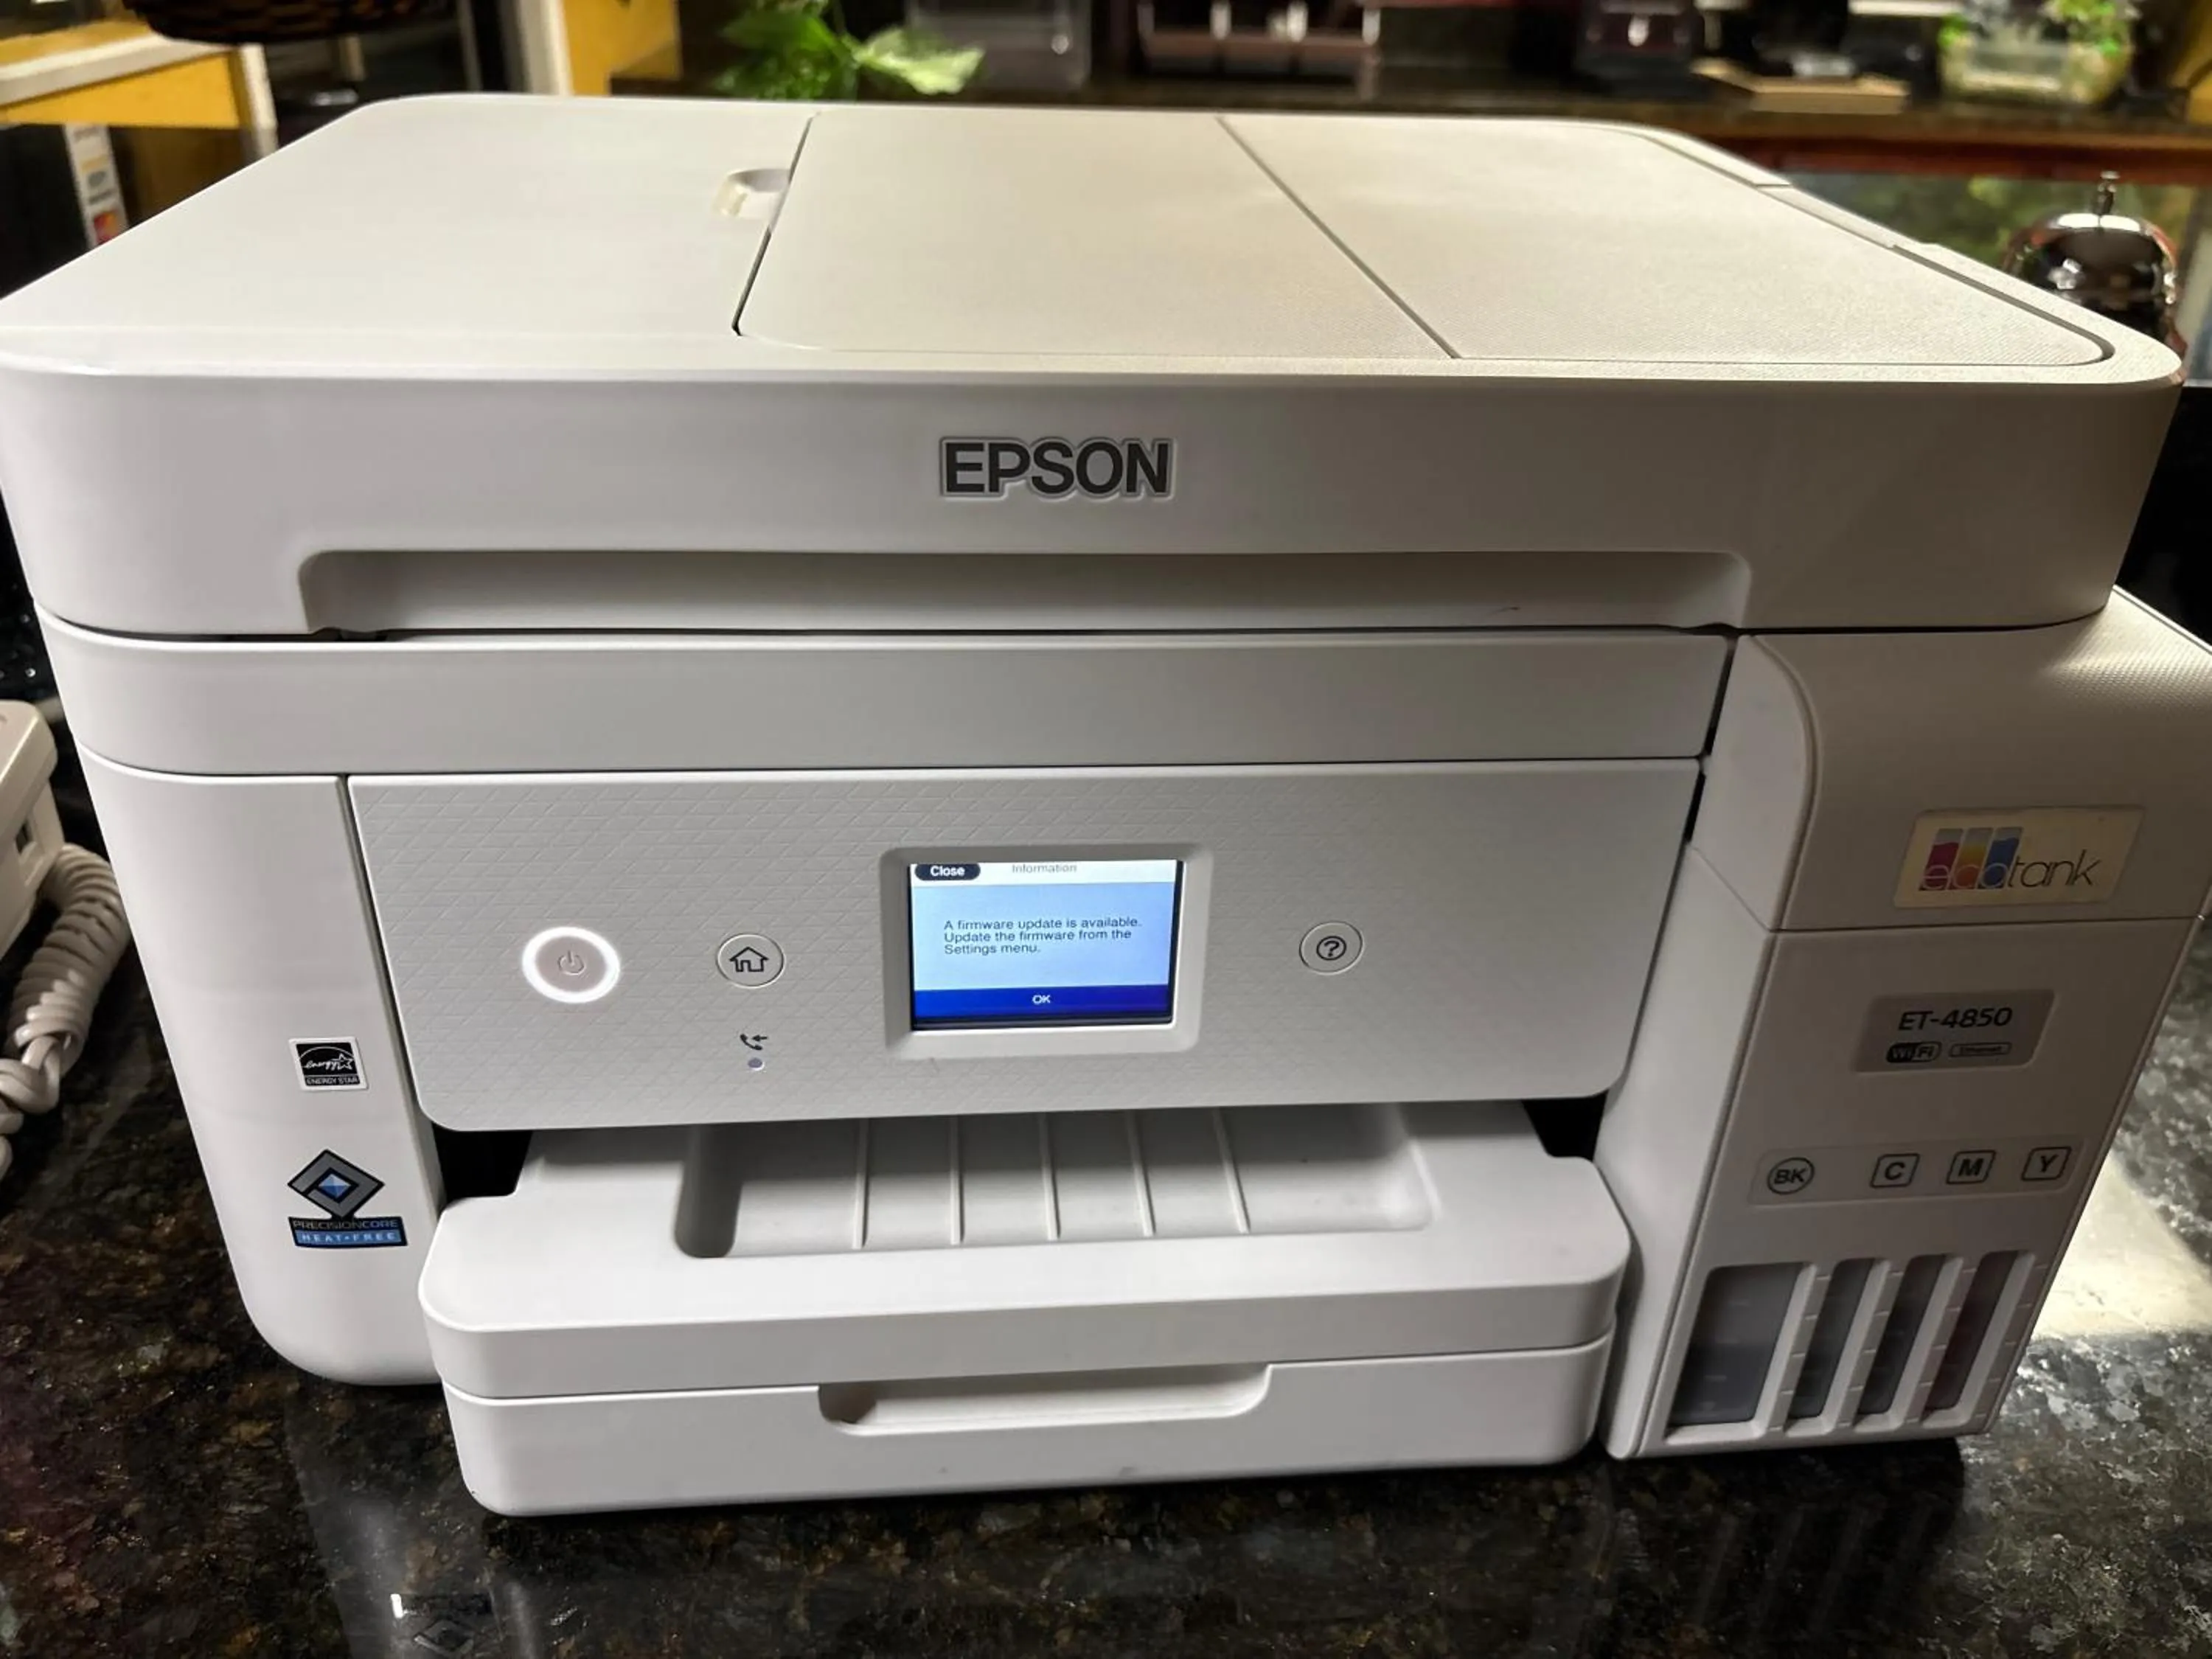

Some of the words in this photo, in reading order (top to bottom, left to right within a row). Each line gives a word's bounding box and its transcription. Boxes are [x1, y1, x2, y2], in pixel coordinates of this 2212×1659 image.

[945, 440, 1170, 495] EPSON
[930, 865, 966, 877] Close
[1012, 863, 1078, 874] Information
[943, 920, 954, 931] A
[958, 919, 1015, 930] firmware
[1018, 918, 1062, 931] update
[1066, 918, 1077, 928] is
[1080, 916, 1142, 928] available.
[944, 932, 992, 944] Update
[995, 931, 1016, 942] the
[1019, 930, 1075, 941] firmware
[1078, 929, 1108, 940] from
[1111, 928, 1133, 939] the
[944, 943, 997, 956] Settings
[1000, 944, 1041, 954] menu.
[1032, 995, 1051, 1004] OK
[1898, 1006, 2014, 1031] ET-4850
[306, 1077, 337, 1085] ENERGY
[338, 1077, 360, 1085] STAR
[1884, 1161, 1907, 1180] C
[1958, 1158, 1983, 1177] M
[2039, 1155, 2059, 1173] Y
[1773, 1166, 1806, 1186] BK
[293, 1220, 399, 1230] PRECISIONCORE
